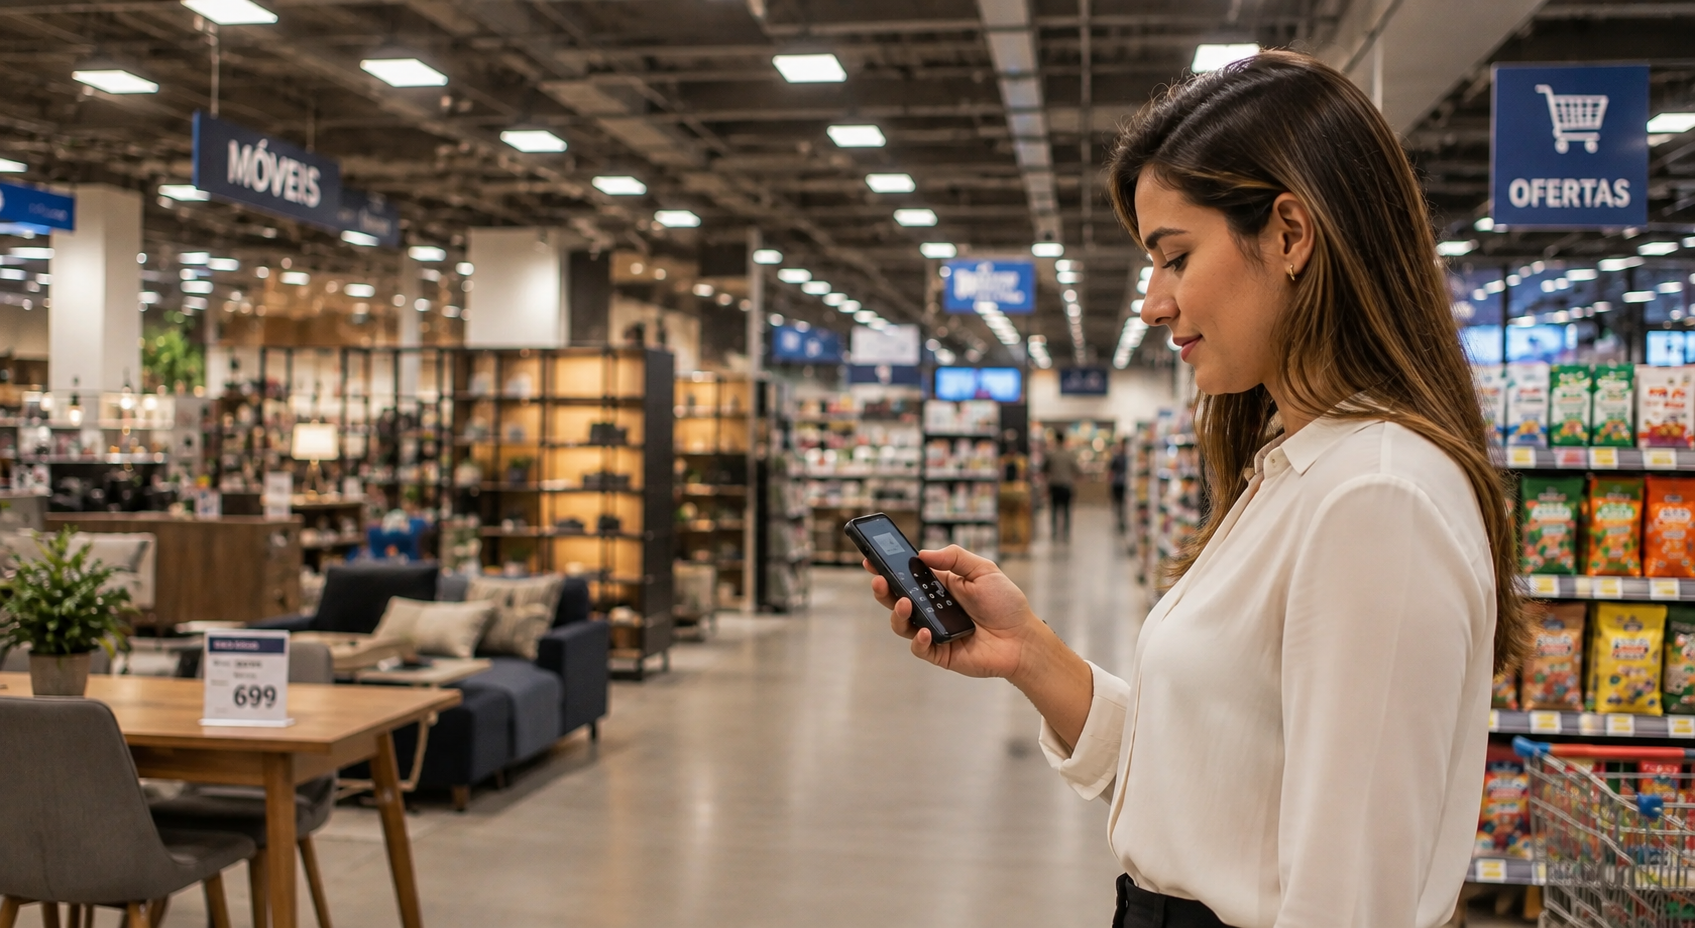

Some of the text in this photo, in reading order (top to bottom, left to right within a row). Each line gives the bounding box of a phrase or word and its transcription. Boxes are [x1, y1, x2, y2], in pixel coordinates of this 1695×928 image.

[227, 138, 321, 208] MÓVEIS
[1509, 178, 1631, 208] OFERTAS
[234, 685, 277, 708] 699
